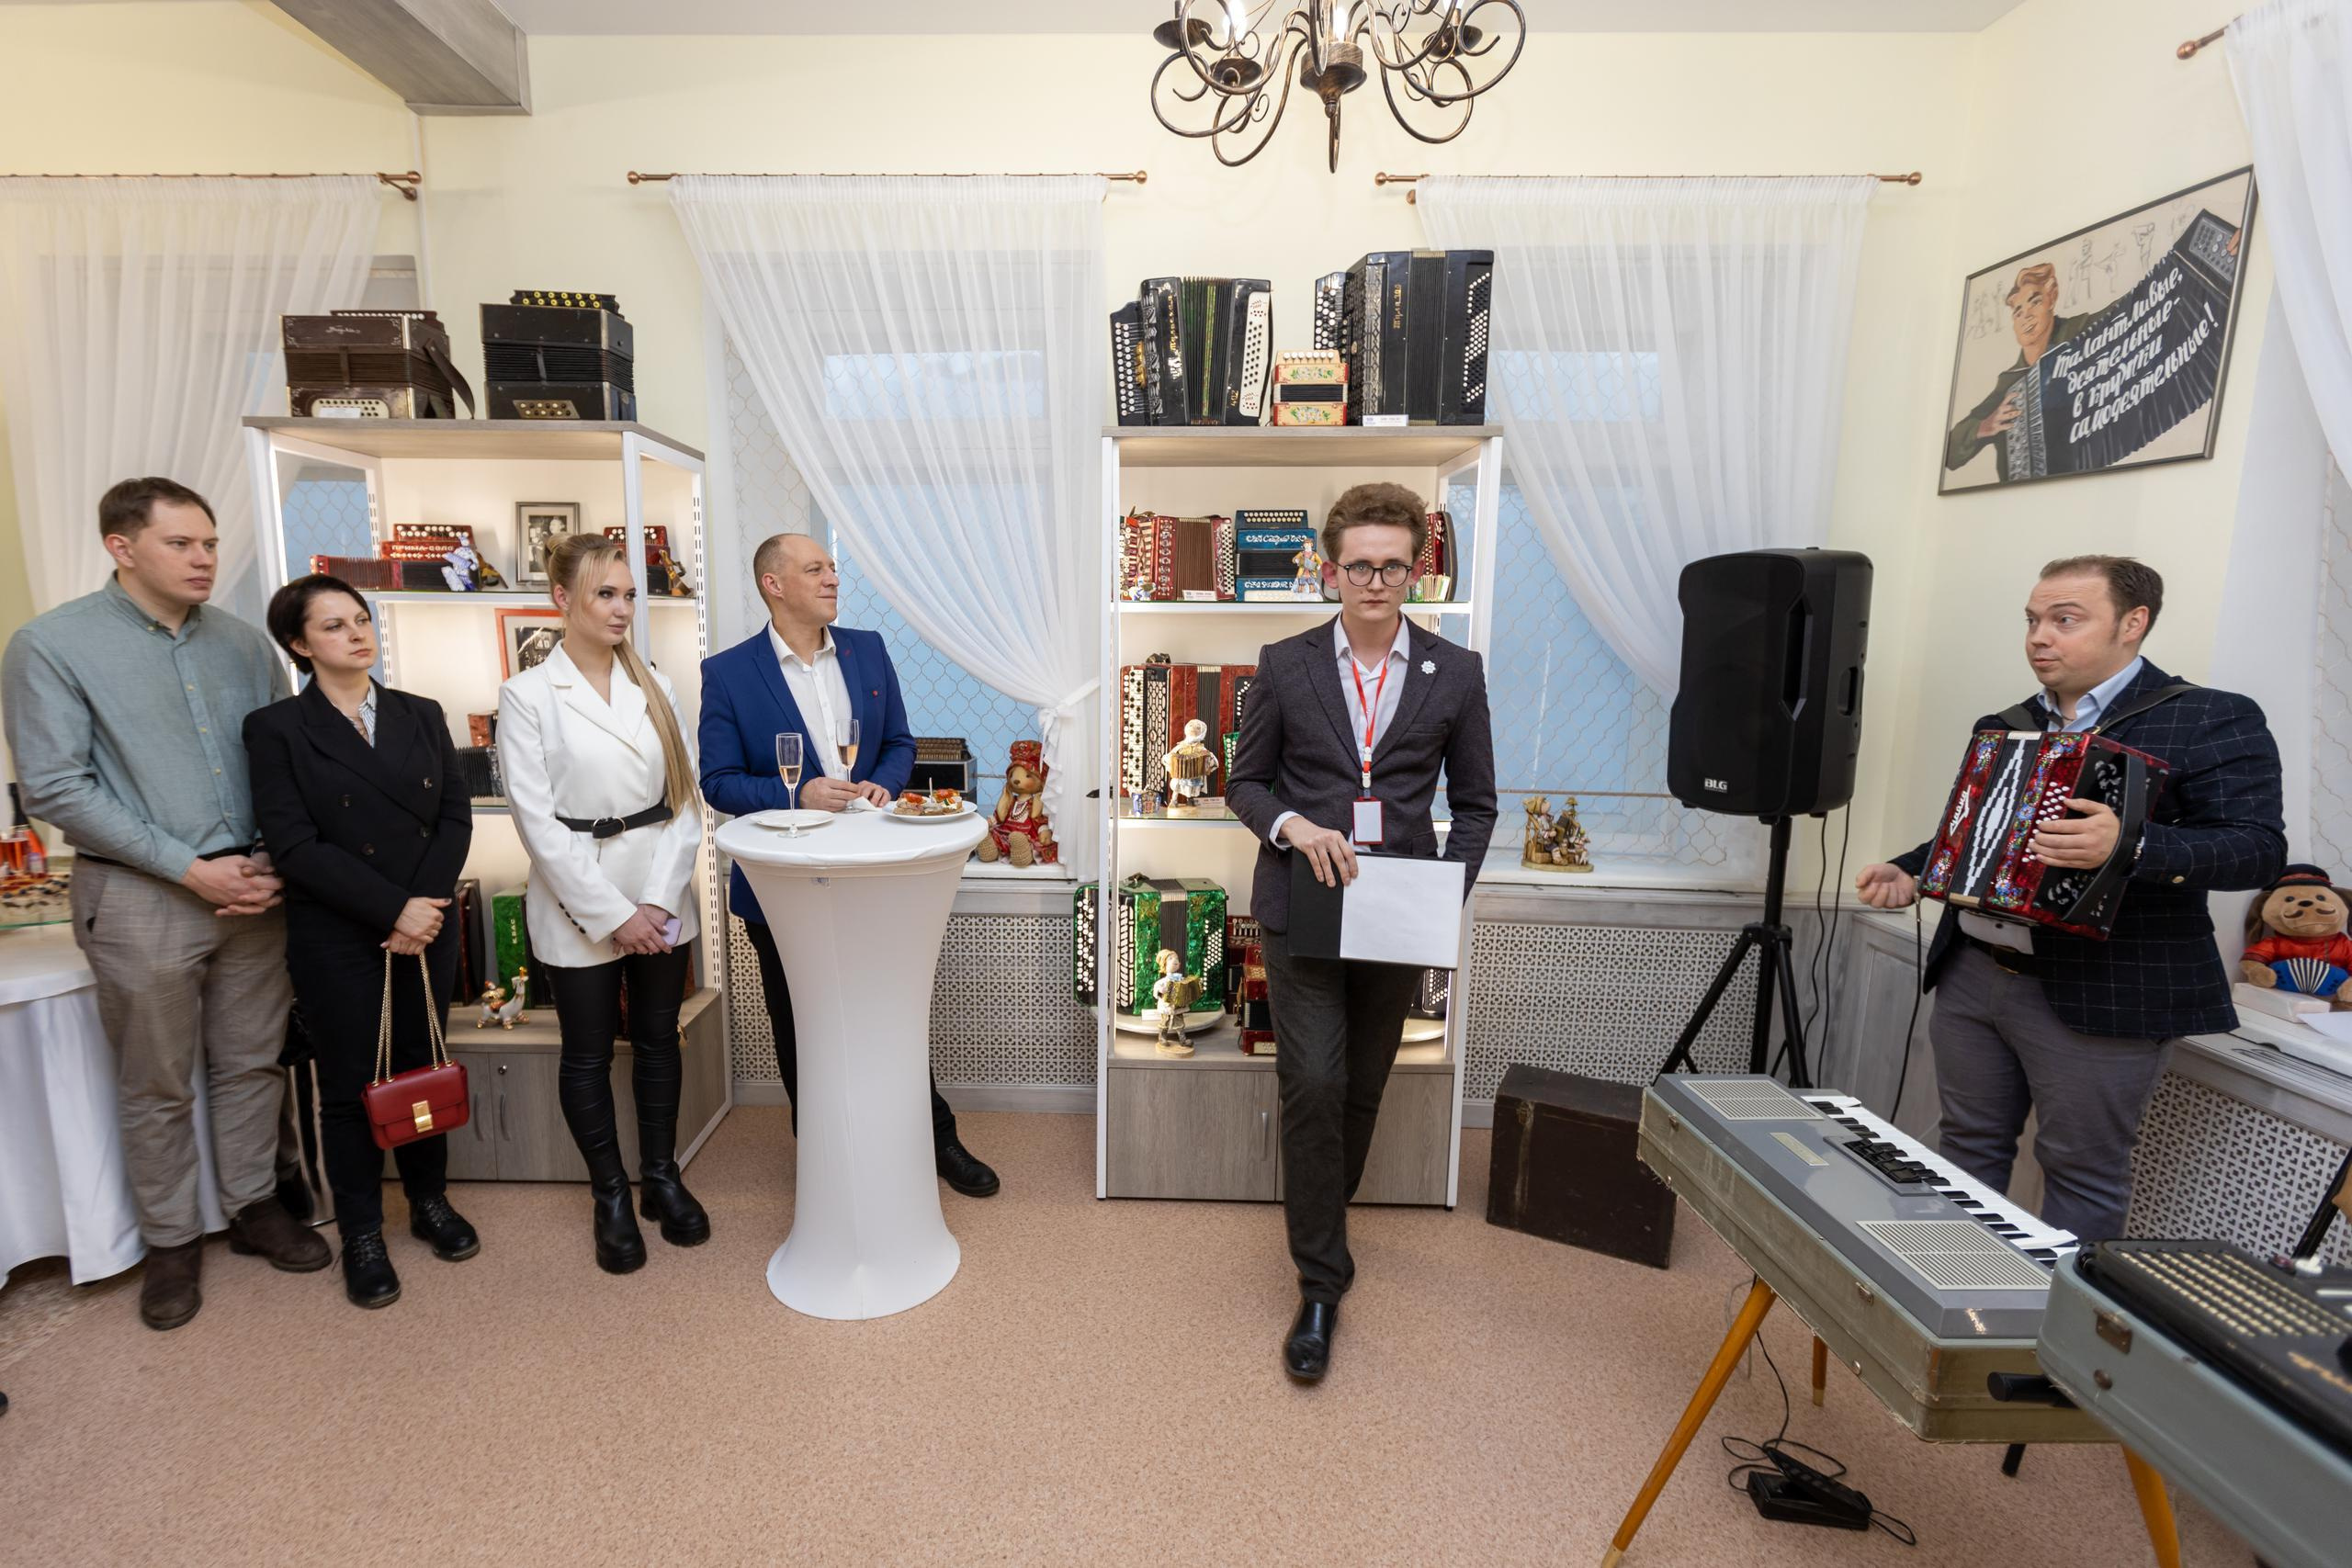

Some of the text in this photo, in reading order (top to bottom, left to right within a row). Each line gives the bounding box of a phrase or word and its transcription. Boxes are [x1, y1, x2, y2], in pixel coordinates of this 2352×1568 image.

[2069, 301, 2219, 444] самодеятельные!
[2073, 334, 2163, 418] в кружки
[391, 544, 454, 552] ПРИМА-СОЛО
[1704, 777, 1727, 790] BLG
